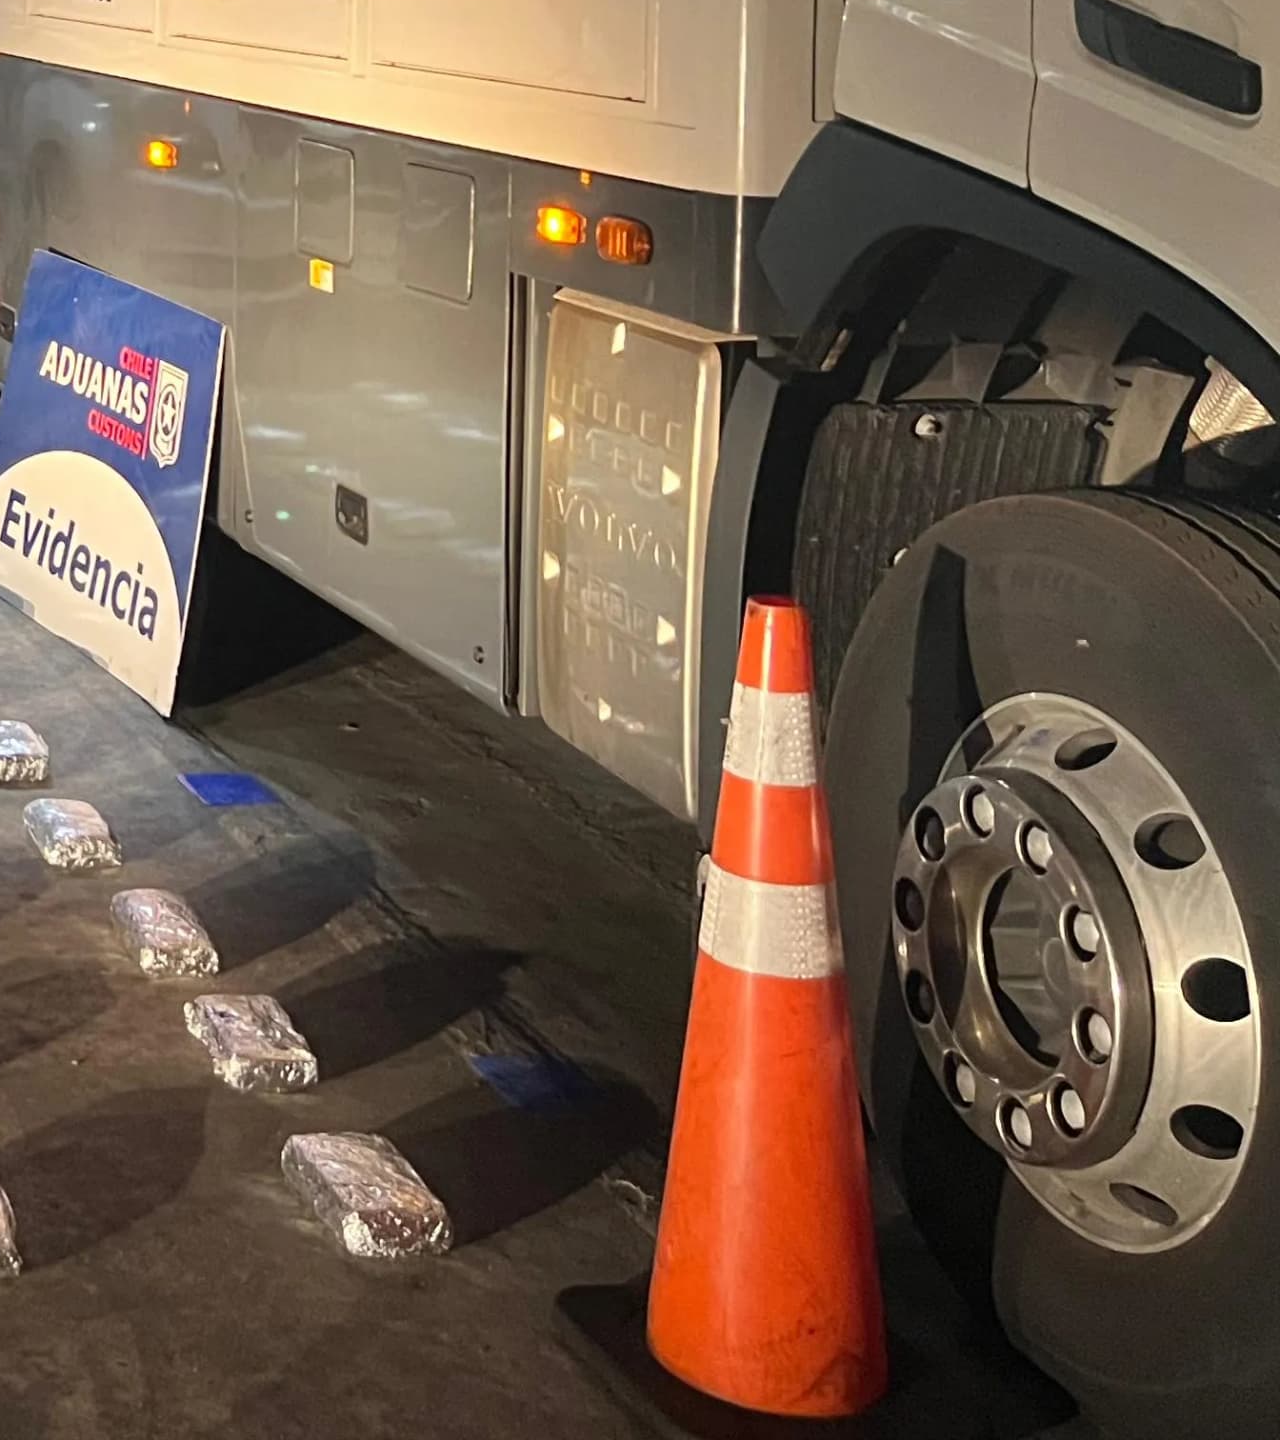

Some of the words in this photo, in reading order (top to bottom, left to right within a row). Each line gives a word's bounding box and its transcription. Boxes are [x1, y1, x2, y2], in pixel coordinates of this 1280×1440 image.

[39, 340, 149, 425] ADUANAS
[119, 346, 152, 380] CHILE
[88, 408, 144, 456] CUSTOMS
[0, 488, 159, 642] Evidencia
